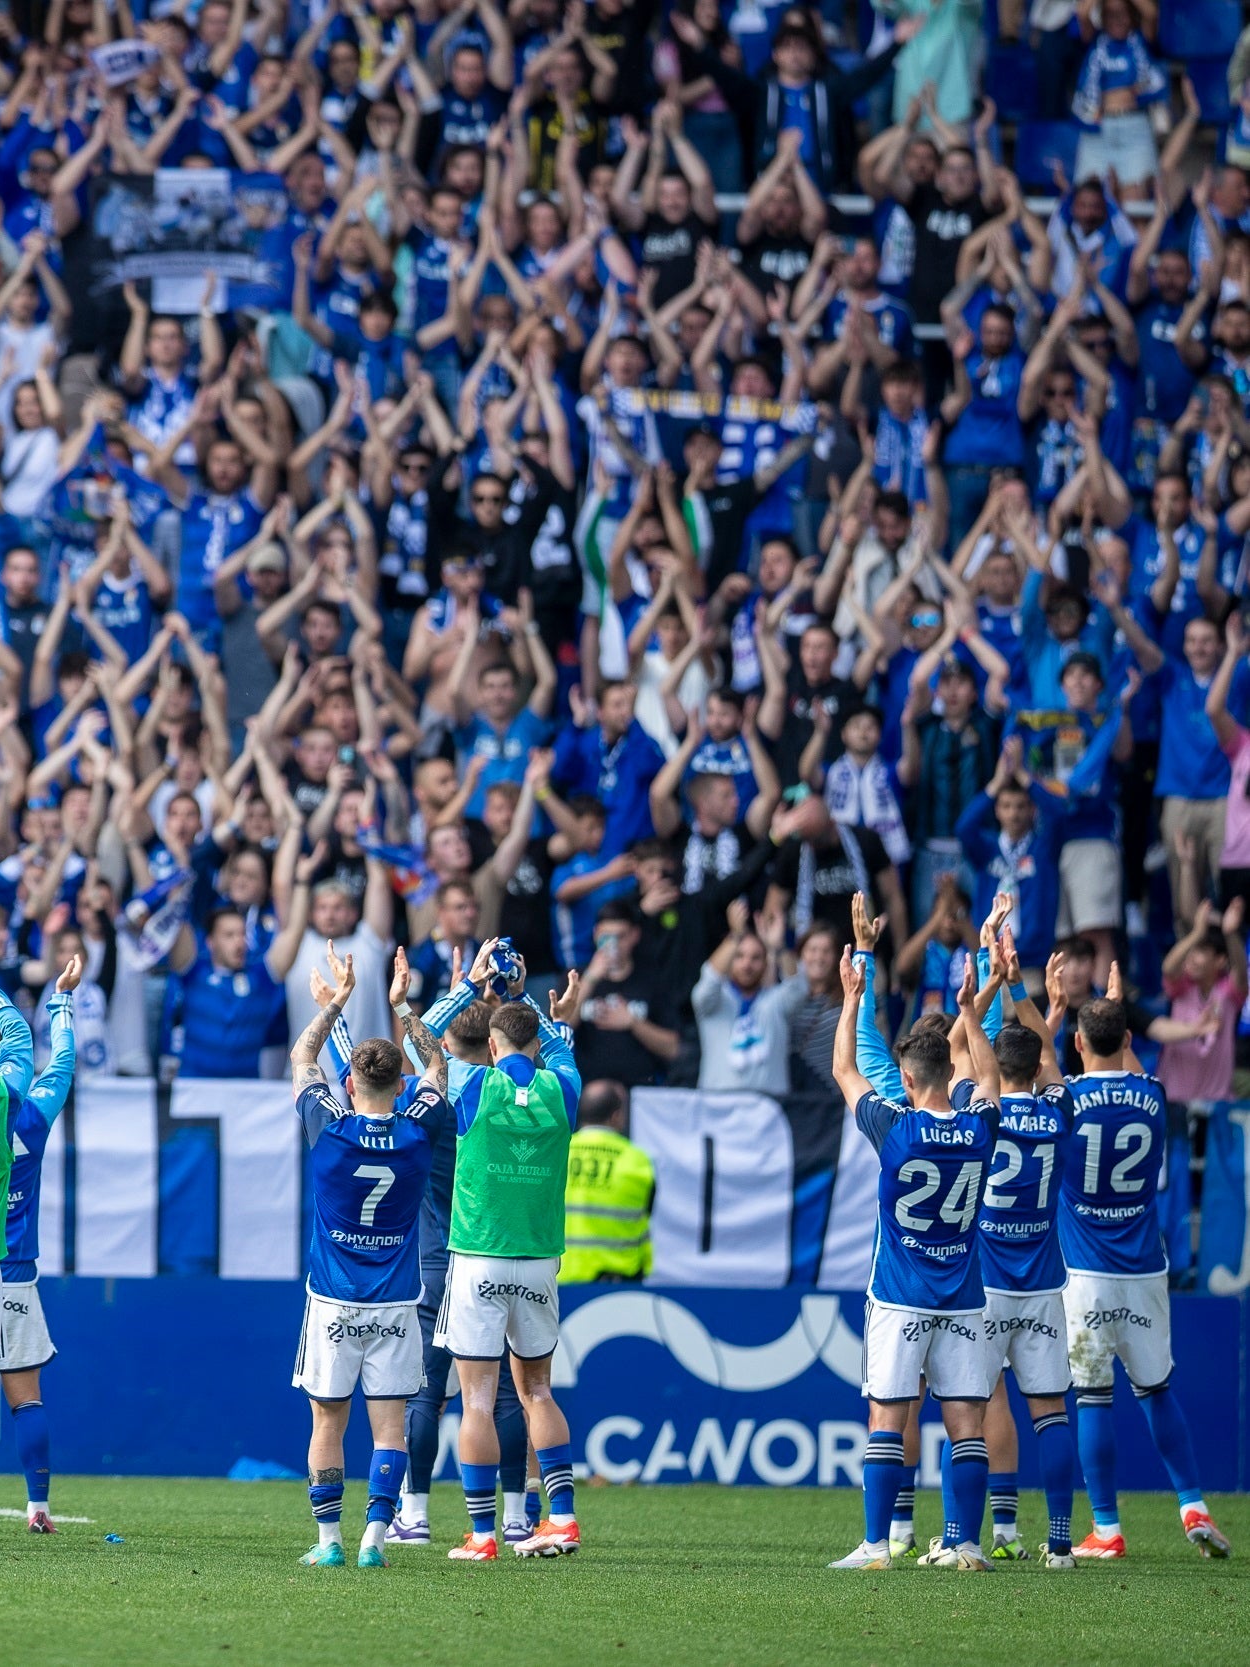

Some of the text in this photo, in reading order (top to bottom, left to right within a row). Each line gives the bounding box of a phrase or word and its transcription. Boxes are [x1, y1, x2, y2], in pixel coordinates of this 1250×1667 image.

[1112, 1089, 1160, 1116] CALVO
[999, 1115, 1058, 1133] MARES
[359, 1135, 395, 1149] VITI
[920, 1127, 975, 1145] LUCAS
[1076, 1122, 1152, 1194] 12
[487, 1163, 552, 1177] CAJA RURAL
[983, 1139, 1056, 1209] 21
[7, 1191, 24, 1202] RAL
[352, 1164, 396, 1227] 7
[895, 1159, 983, 1233] 24
[997, 1219, 1050, 1234] HYUNDAI
[347, 1233, 404, 1246] HYUNDAI
[919, 1243, 968, 1257] UNDAI
[497, 1283, 549, 1306] DEXTOOLS
[347, 1322, 407, 1339] DEXTOOLS
[1000, 1317, 1058, 1339] DEXTOOLS
